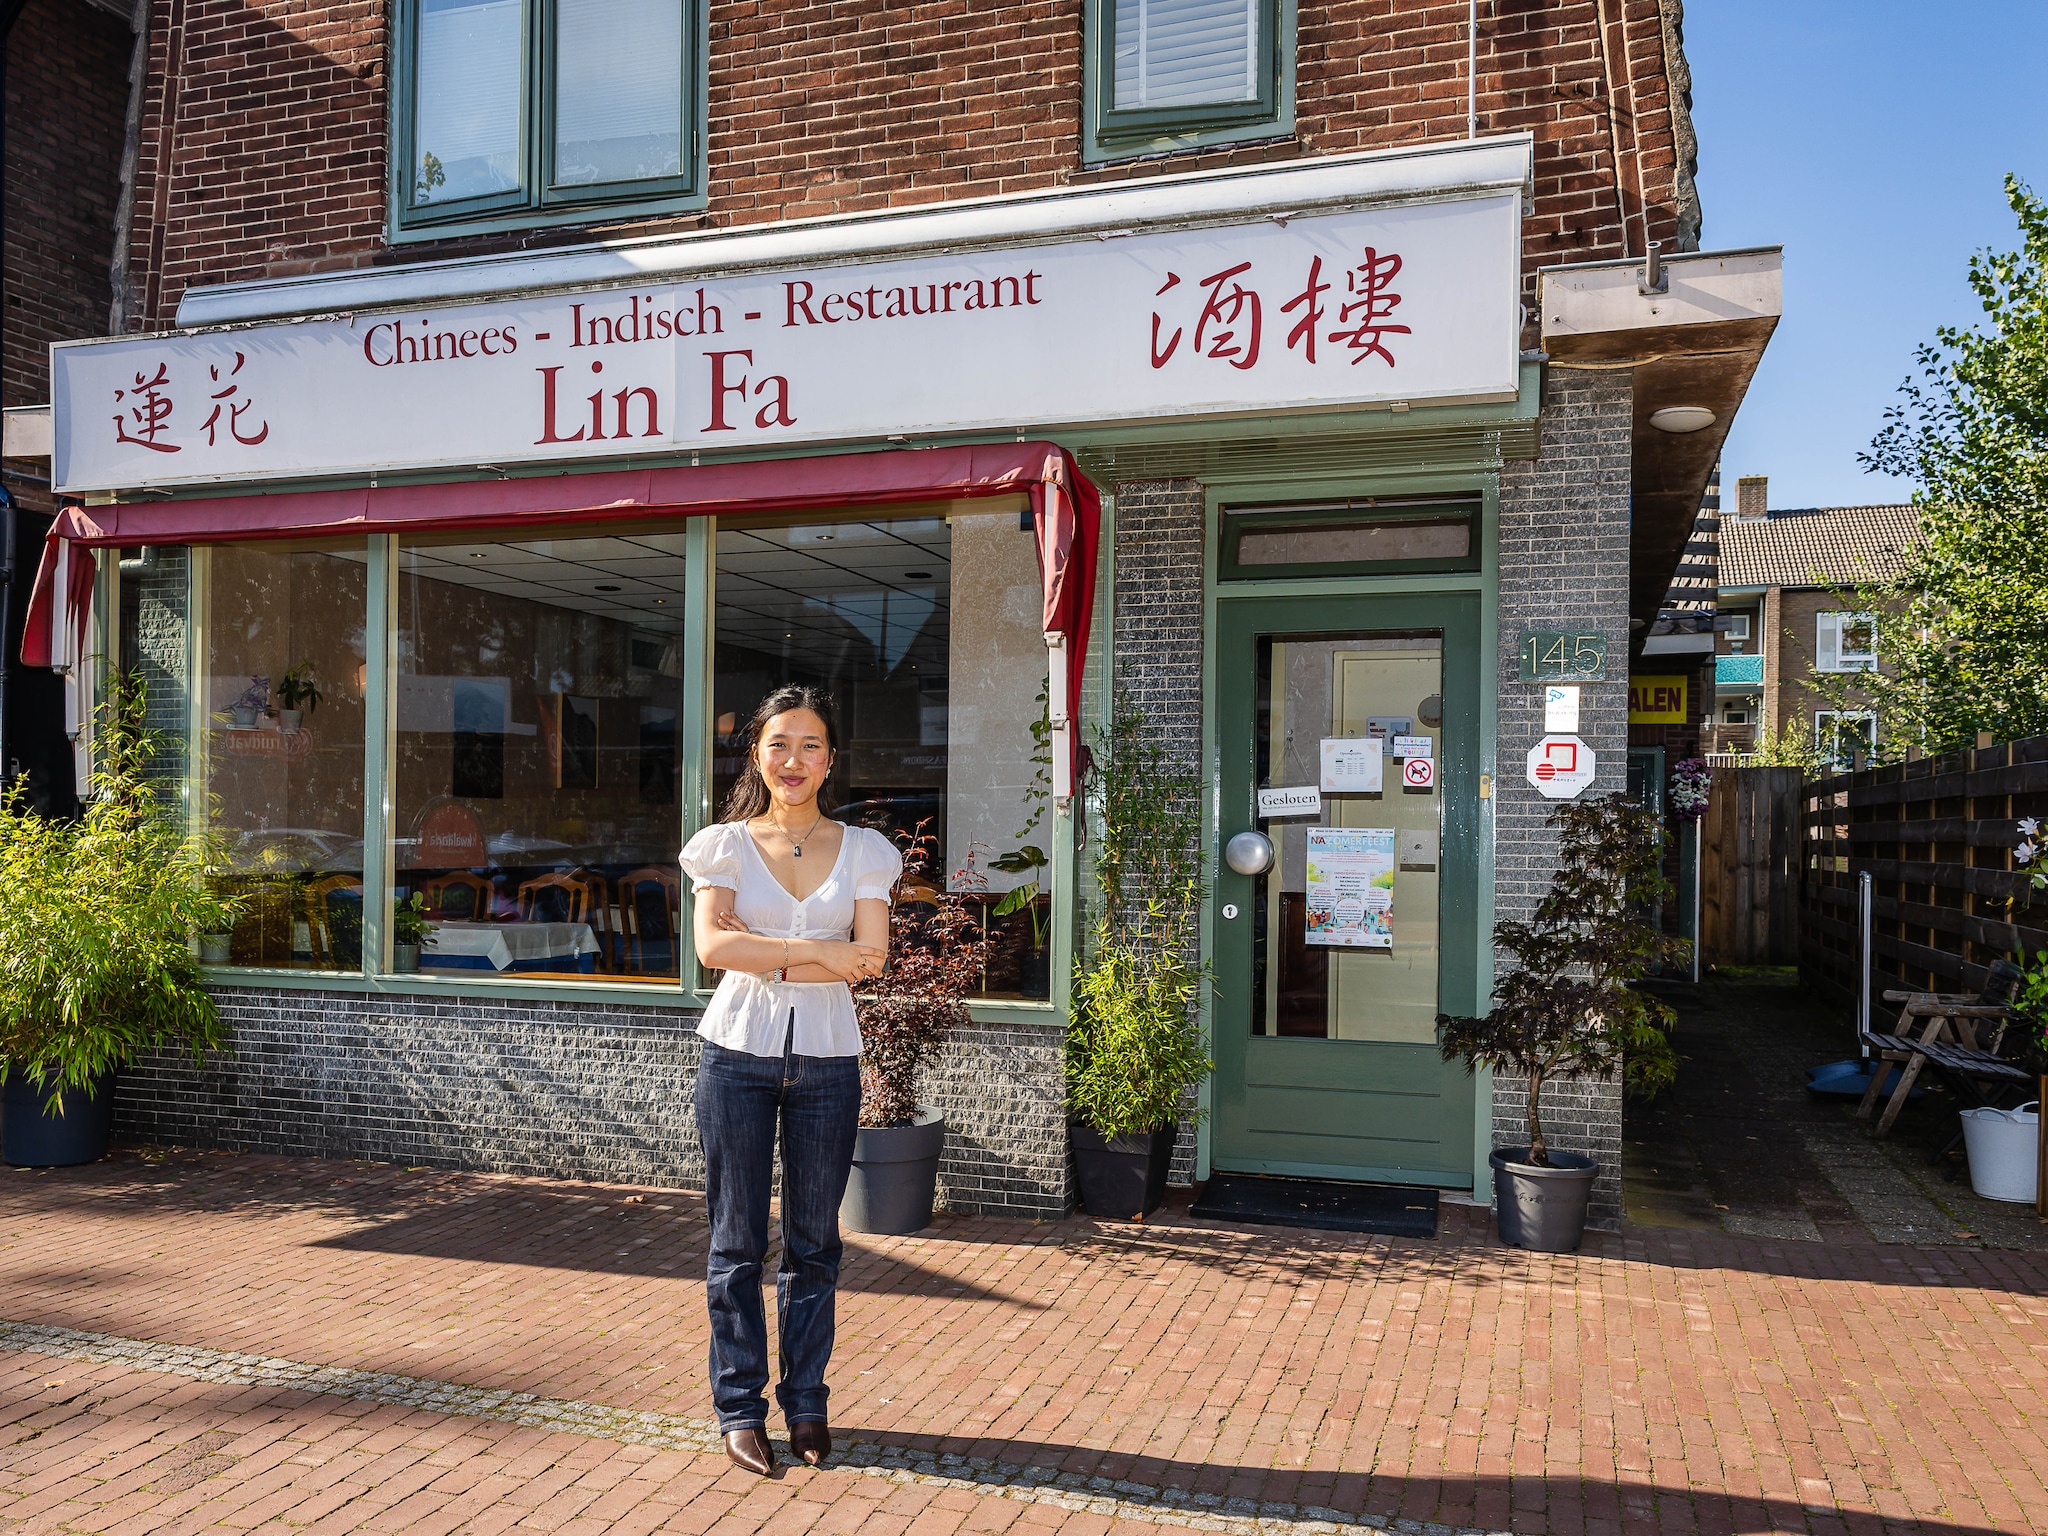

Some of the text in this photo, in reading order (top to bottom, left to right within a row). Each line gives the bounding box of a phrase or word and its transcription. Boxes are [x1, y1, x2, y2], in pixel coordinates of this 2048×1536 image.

[363, 322, 518, 368] Chinees
[568, 288, 723, 347] Indisch
[781, 268, 1043, 328] Restaurant
[1150, 246, 1412, 370] 酒樓
[112, 351, 269, 454] 蓮花
[533, 348, 798, 446] Lin Fa
[1528, 635, 1601, 675] 145
[1261, 792, 1317, 806] Gesloten
[1310, 835, 1391, 847] NAZOMERFEEST
